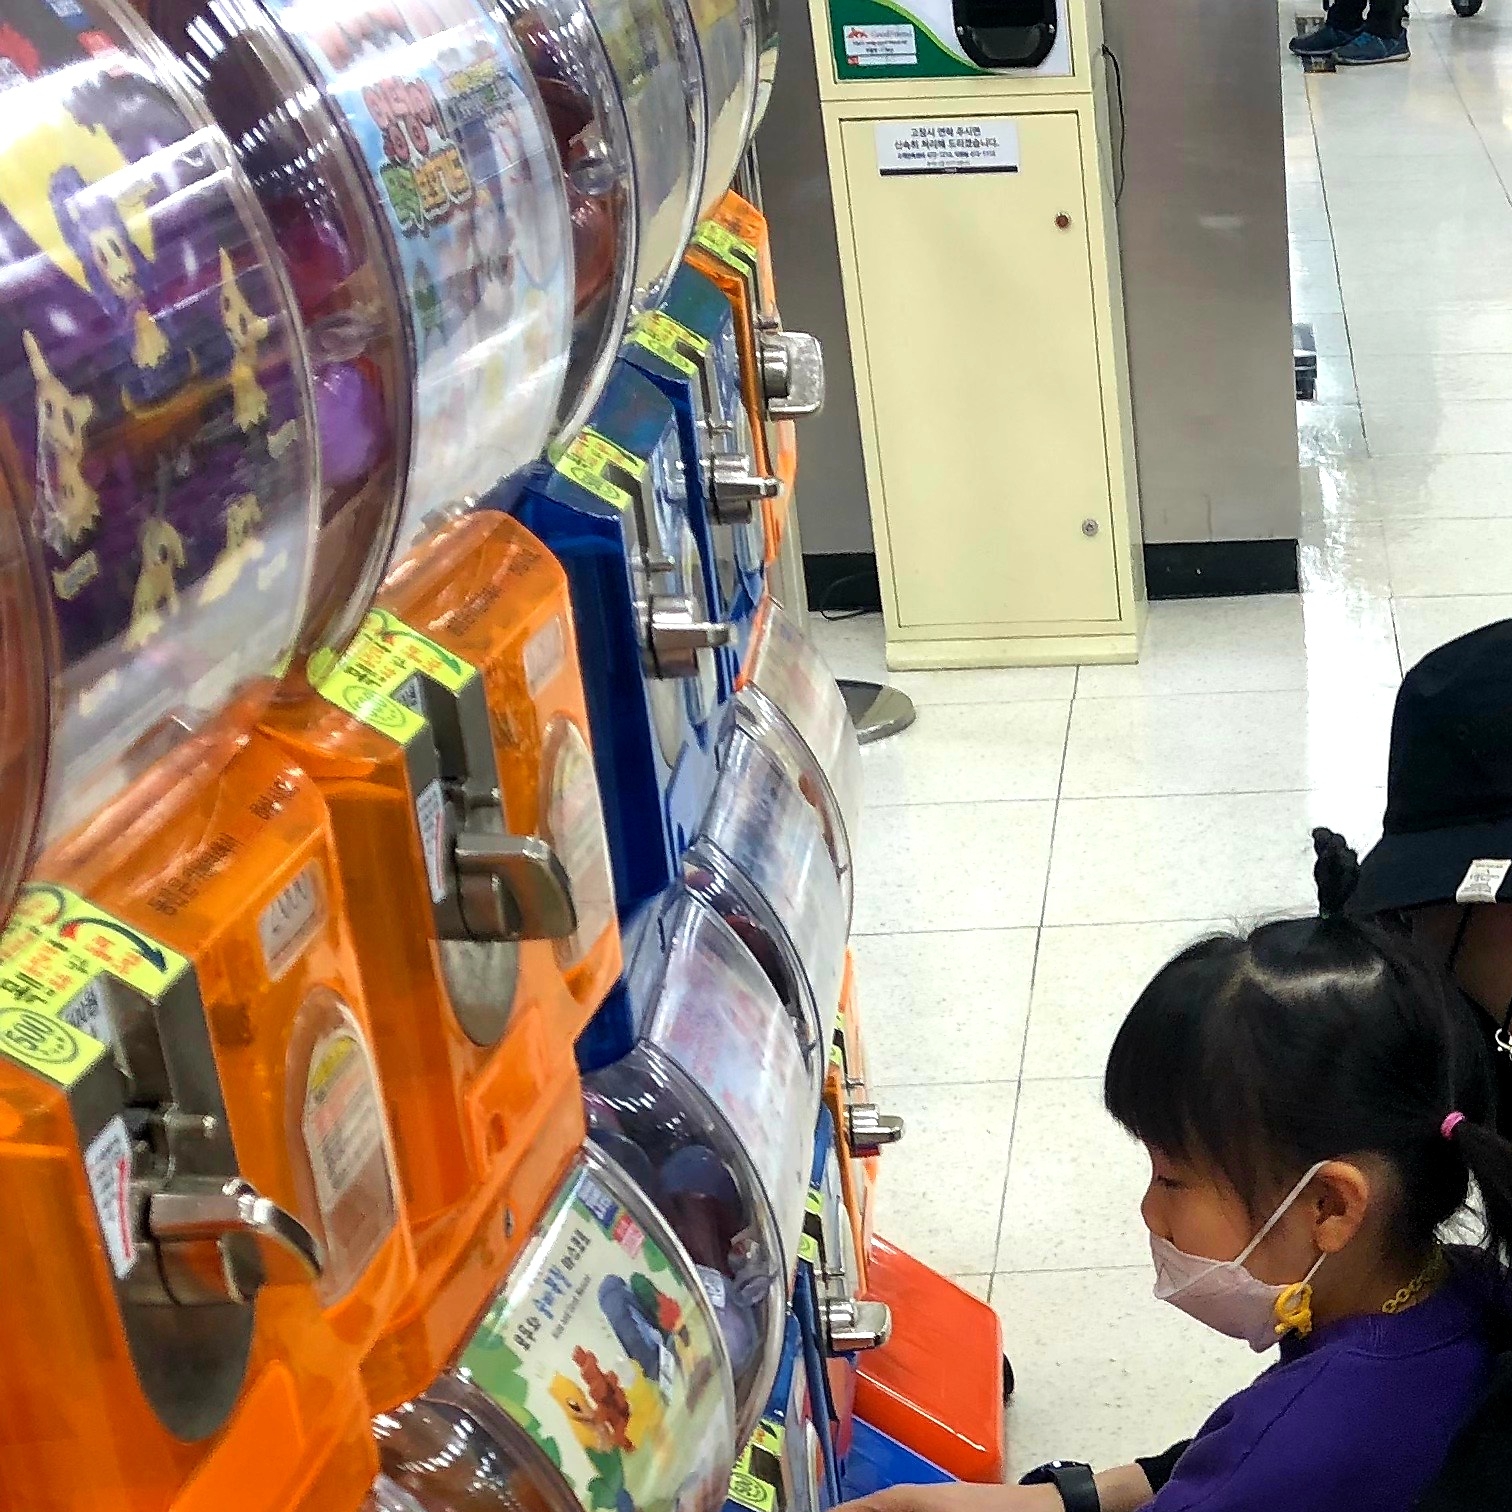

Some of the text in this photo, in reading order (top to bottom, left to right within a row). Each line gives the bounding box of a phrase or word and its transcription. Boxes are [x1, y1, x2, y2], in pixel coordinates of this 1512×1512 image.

[910, 126, 981, 138] 고장시 연락 주시면
[894, 139, 919, 150] 신속히
[5, 1012, 54, 1051] 500
